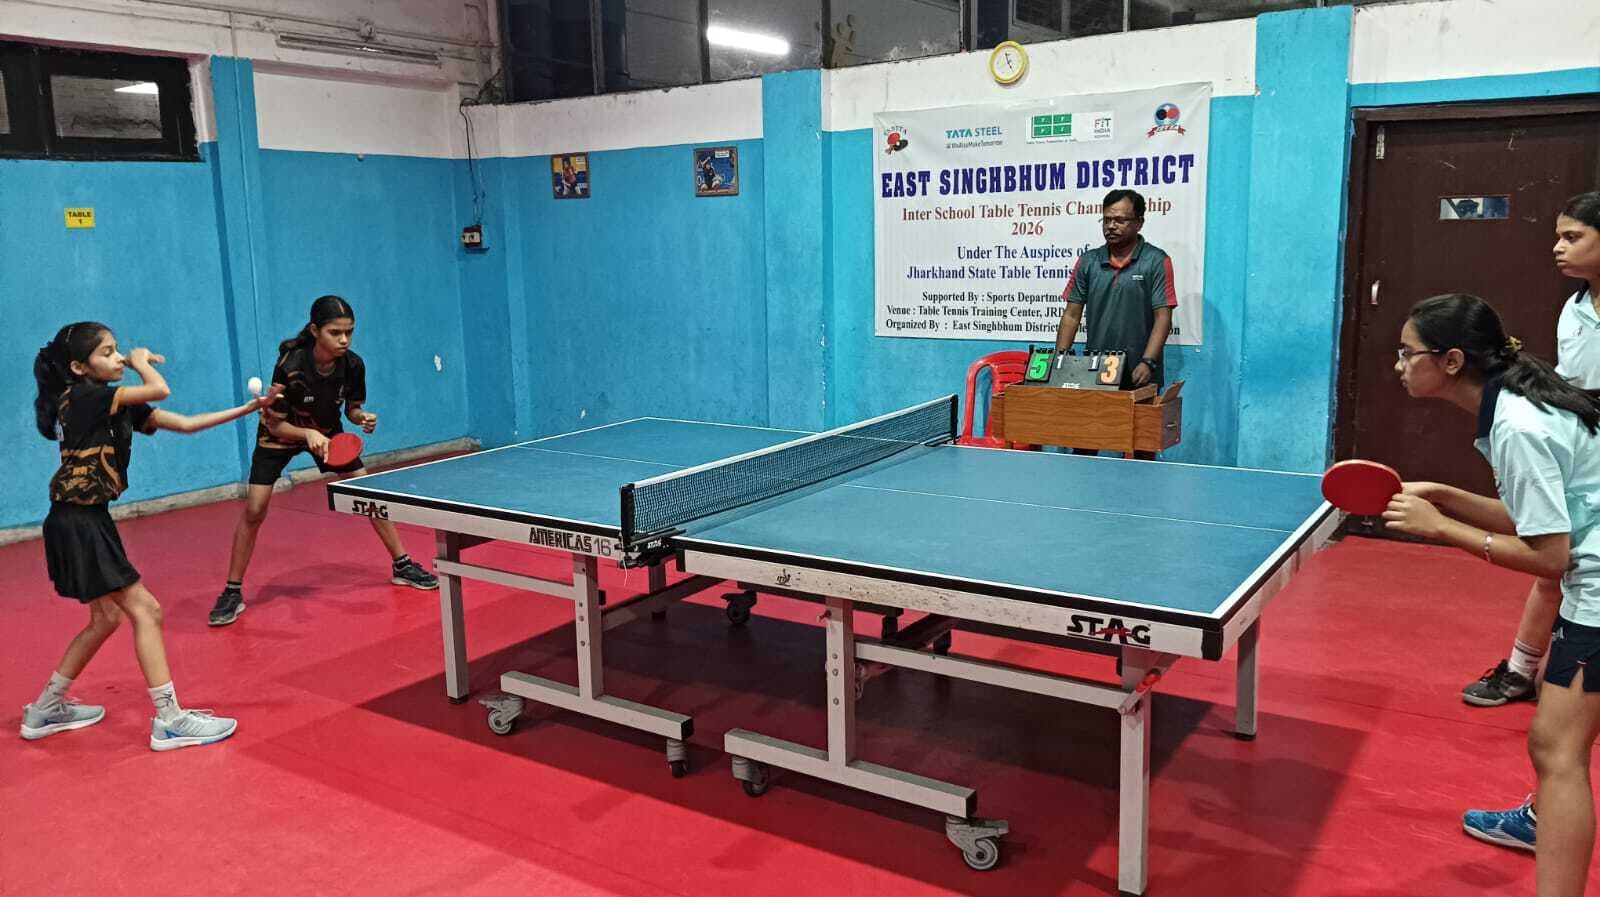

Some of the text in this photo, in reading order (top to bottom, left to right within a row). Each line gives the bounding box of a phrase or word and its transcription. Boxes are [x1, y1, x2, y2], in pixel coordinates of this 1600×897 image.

[945, 126, 1003, 139] TATA STEEL
[881, 153, 1195, 198] EAST SINGHBHUM DISTRICT
[902, 207, 932, 221] Inter
[935, 205, 975, 220] School
[978, 203, 1015, 218] Table
[1017, 202, 1061, 217] Tennis
[1011, 219, 1044, 236] 2026
[957, 242, 1090, 262] Under The Auspices of
[907, 265, 1073, 280] Jharkhand State Table Tennis
[922, 291, 965, 304] Supported
[967, 291, 979, 304] By
[986, 292, 1015, 303] Sports
[1017, 291, 1066, 304] Departme
[887, 305, 911, 315] Venue
[917, 305, 940, 316] Table
[942, 305, 969, 316] Tennis
[970, 306, 1008, 319] Training
[1010, 306, 1042, 318] Center,
[886, 318, 927, 331] Organized
[929, 319, 940, 332] By
[952, 320, 971, 331] East
[972, 320, 1023, 333] Singhbhum
[1029, 352, 1120, 384] 5 1 1 3
[351, 500, 389, 520] STAG
[528, 527, 612, 556] AMERICAS 16
[1066, 614, 1151, 646] STAG
